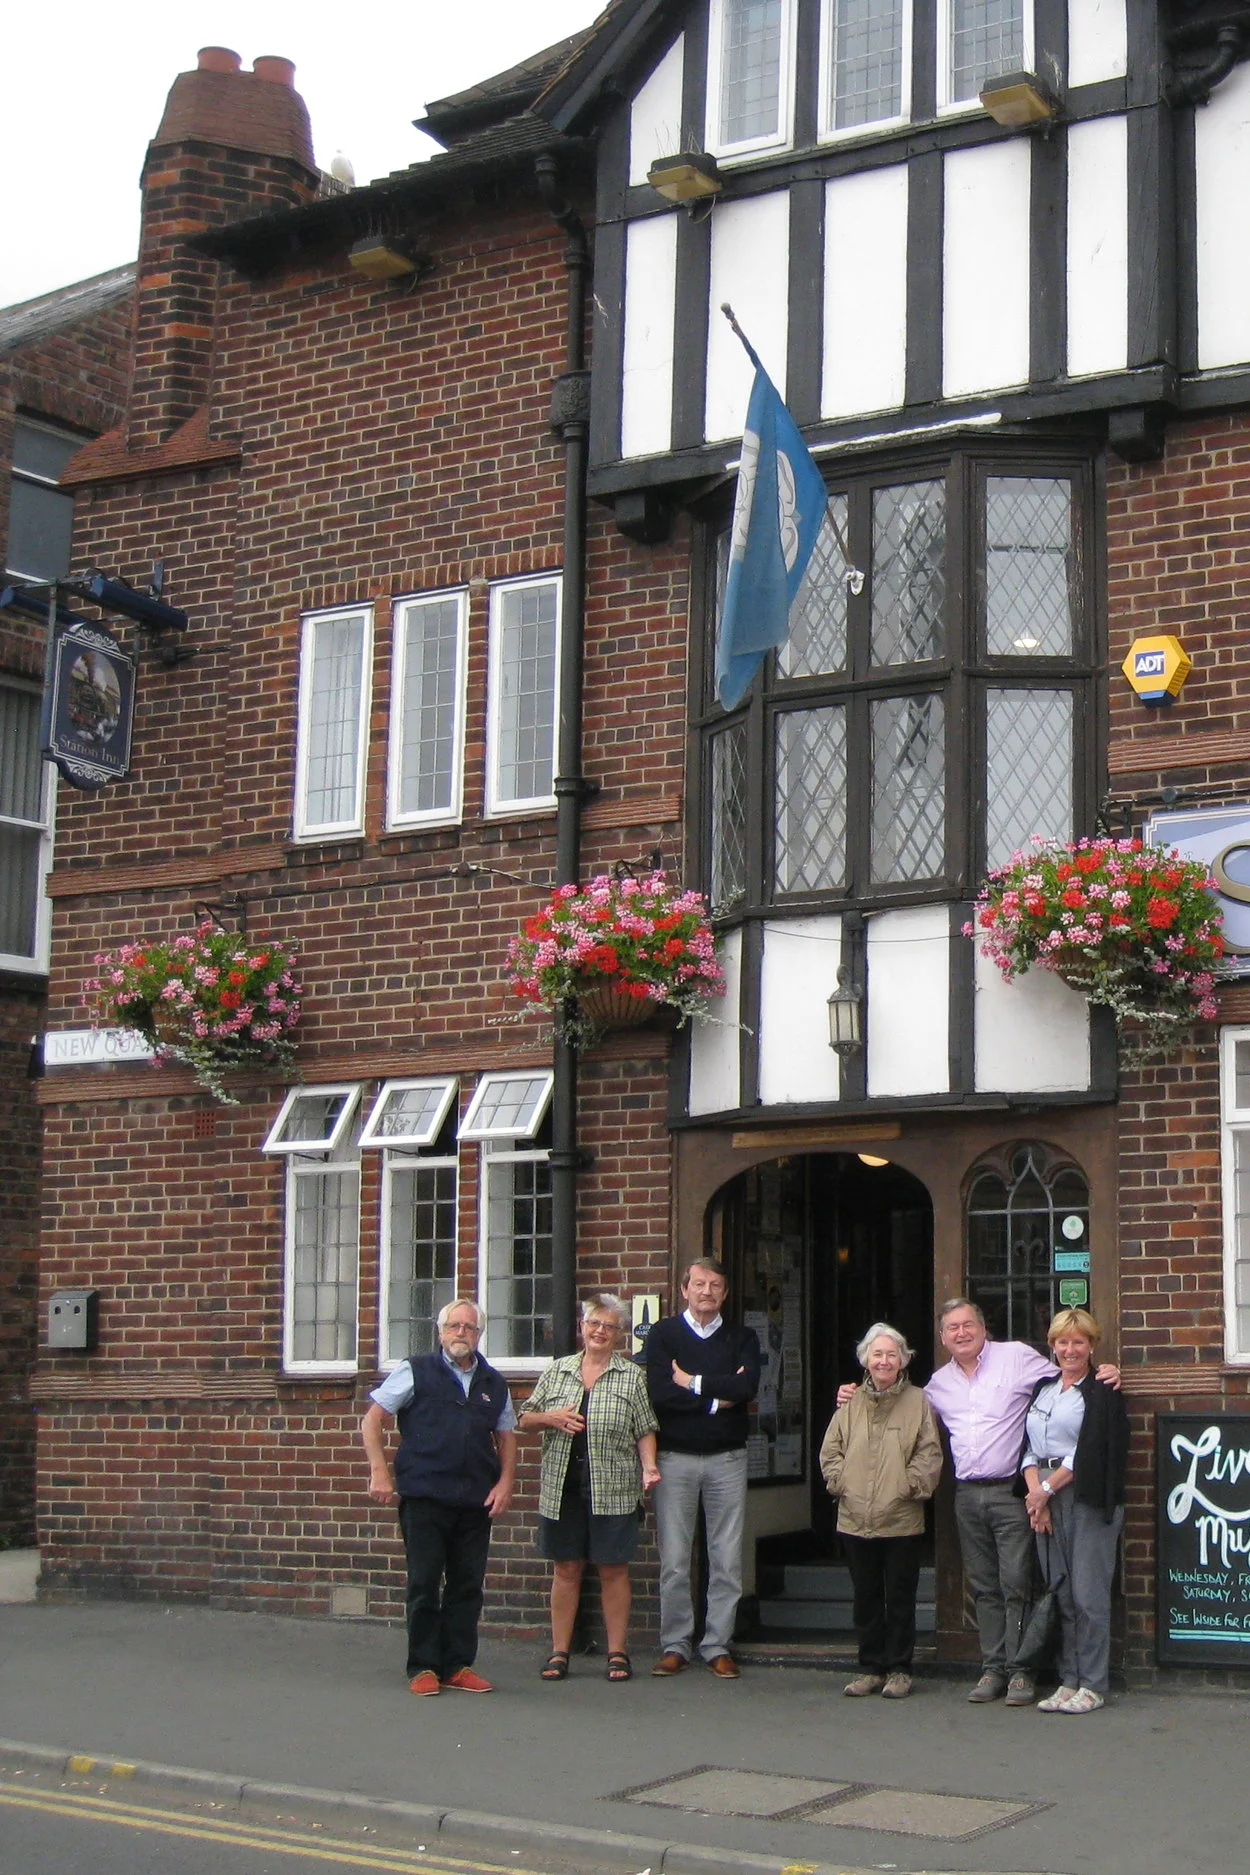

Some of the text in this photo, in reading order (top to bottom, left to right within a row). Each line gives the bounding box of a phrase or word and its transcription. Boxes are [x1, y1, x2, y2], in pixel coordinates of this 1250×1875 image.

[1135, 655, 1165, 674] ADT
[60, 734, 120, 764] Station Inn
[55, 1035, 147, 1057] NEW QUA
[1169, 1607, 1190, 1625] SEE
[1193, 1608, 1222, 1626] INSIDE
